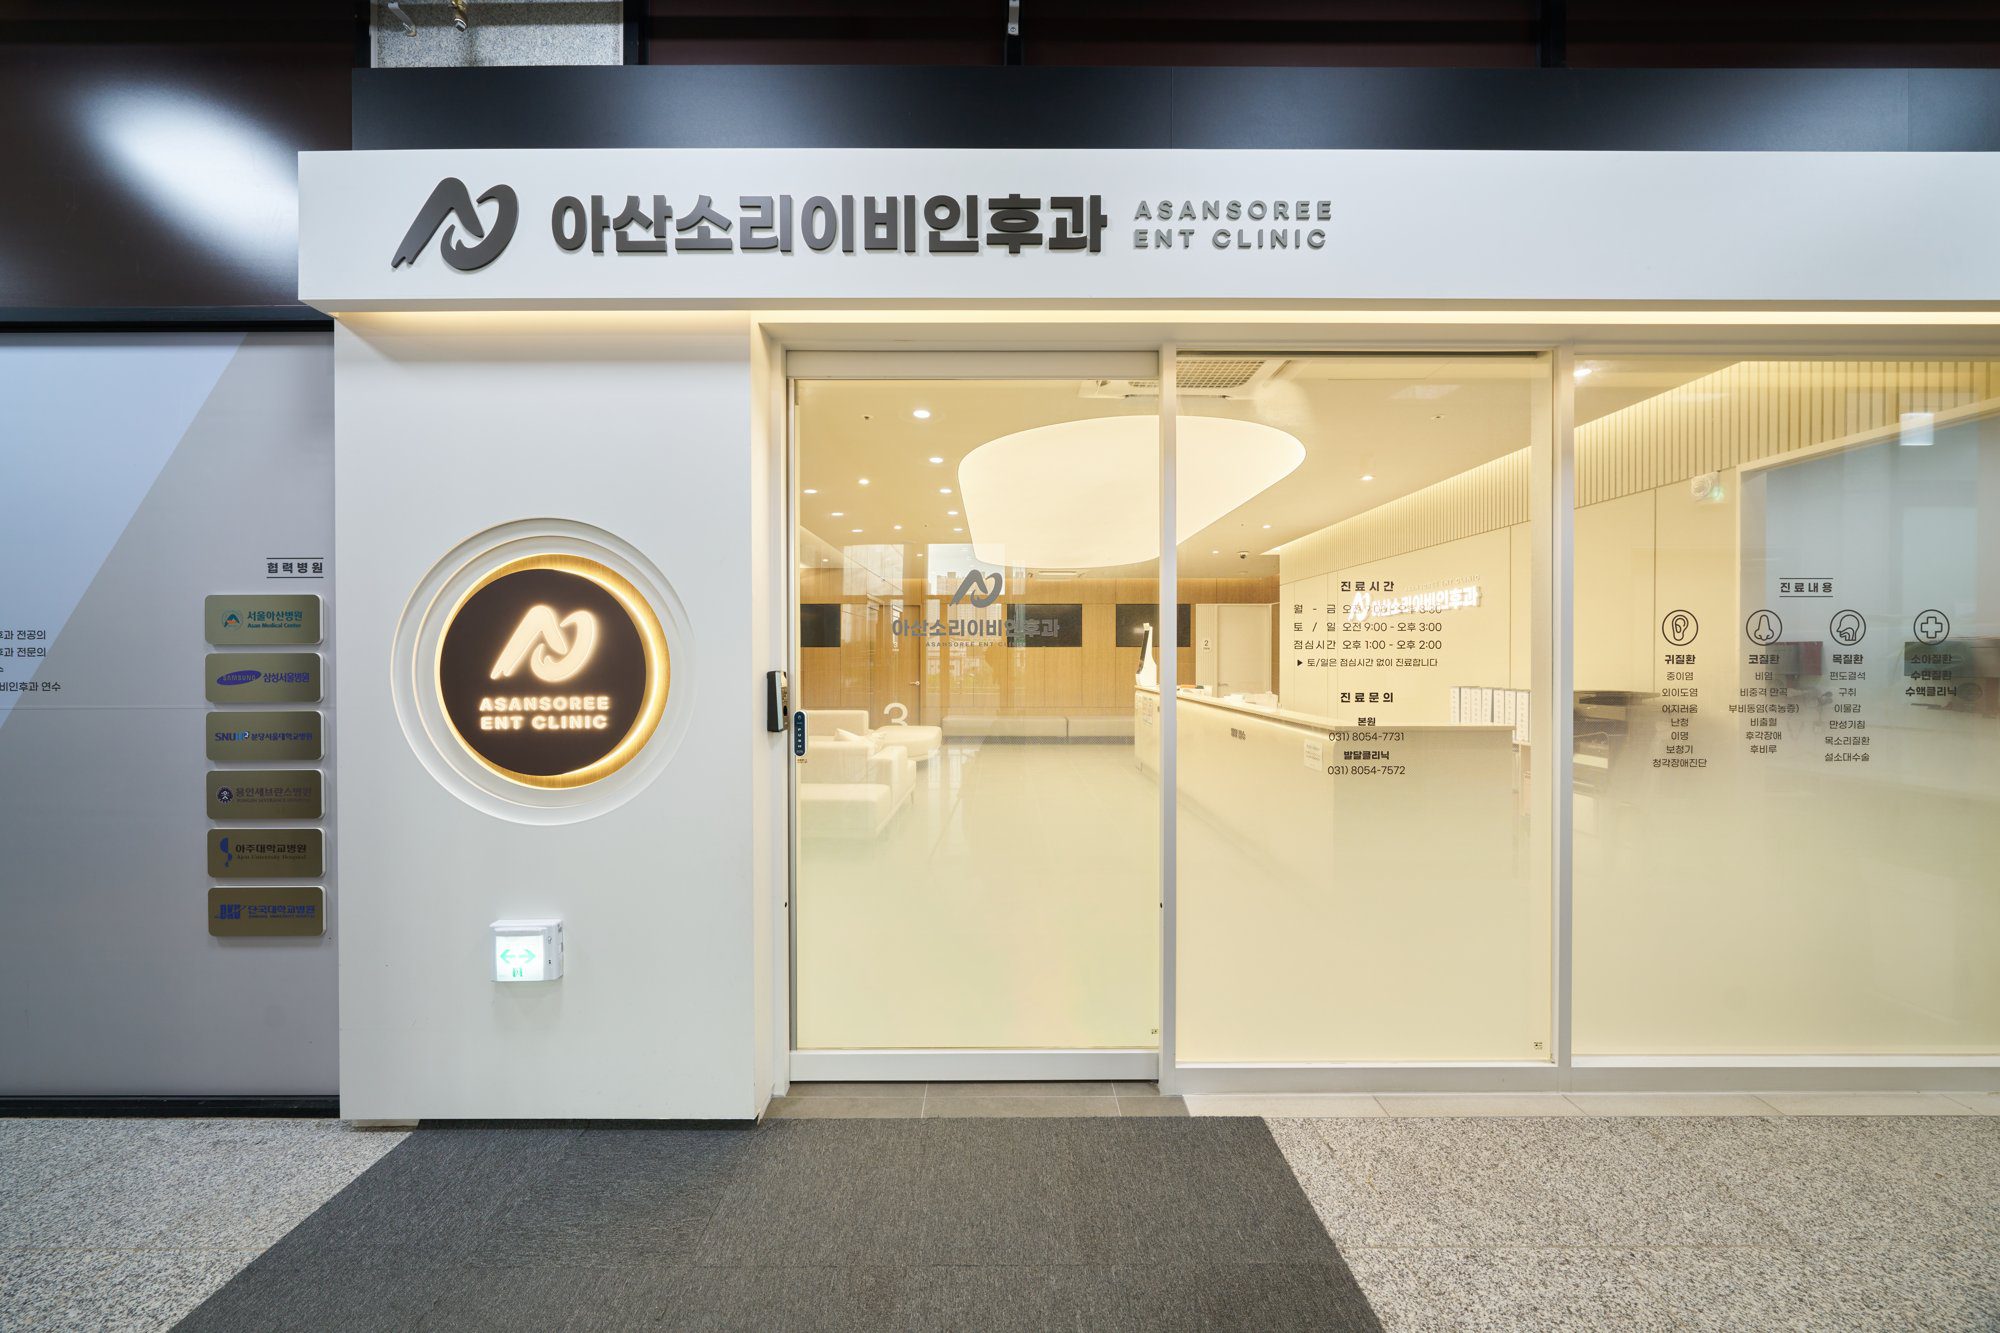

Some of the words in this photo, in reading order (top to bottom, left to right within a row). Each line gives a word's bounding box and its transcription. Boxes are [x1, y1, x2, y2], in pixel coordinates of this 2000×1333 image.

[1134, 200, 1332, 220] ASANSOREE
[551, 193, 1108, 253] 아산소리이비인후과
[1134, 229, 1195, 248] ENT
[1212, 229, 1326, 248] CLINIC
[267, 562, 323, 574] 협력병원
[1340, 581, 1394, 592] 진료시간
[1780, 582, 1833, 593] 진료내용
[1294, 604, 1303, 614] 월
[1326, 604, 1336, 614] 금
[248, 610, 302, 622] 서울아산병원
[892, 619, 1060, 638] 아산소리이비인후과
[1294, 622, 1303, 632] 토
[1326, 622, 1336, 632] 일
[1342, 622, 1362, 632] 오전
[1364, 622, 1388, 632] 9:00
[1397, 622, 1416, 632] 오후
[1419, 622, 1442, 632] 3:00
[17, 630, 46, 640] 전공의
[1294, 640, 1336, 650] 점심시간
[1342, 640, 1362, 650] 오후
[1365, 640, 1386, 650] 1:00
[1396, 640, 1416, 650] 오후
[1419, 640, 1442, 650] 2:00
[17, 648, 46, 657] 전문의
[1308, 659, 1336, 667] 토/일은
[1340, 659, 1374, 667] 점심시간
[1376, 659, 1393, 667] 없이
[1396, 659, 1438, 667] 진료합니다
[1664, 654, 1696, 664] 귀질환
[1748, 654, 1780, 664] 코질환
[1832, 654, 1864, 664] 목질환
[1910, 654, 1952, 664] 소아질환
[264, 672, 310, 683] 삼성서울병원
[1666, 672, 1694, 680] 중이염
[1755, 672, 1773, 680] 비염
[1830, 672, 1866, 680] 편도결석
[0, 682, 38, 692] 비인후과
[42, 682, 61, 691] 연수
[1838, 688, 1857, 696] 구취
[1905, 686, 1957, 696] 수액클리닉
[1340, 692, 1394, 703] 진료문의
[1662, 688, 1698, 697] 외이도염
[1740, 688, 1766, 697] 비중격
[1770, 688, 1788, 696] 만곡
[478, 696, 610, 712] ASANSOREE
[1662, 704, 1698, 714] 어지러움
[1728, 704, 1800, 714] 부비동염(축농증)
[1834, 704, 1861, 713] 이물감
[480, 716, 524, 730] ENT
[531, 715, 608, 730] CLINIC
[1358, 717, 1376, 726] 본원
[1670, 718, 1688, 727] 난청
[1750, 718, 1777, 727] 비출혈
[1830, 720, 1866, 730] 만성기침
[1328, 732, 1350, 742] 031)
[1352, 732, 1404, 742] 8054-7731
[1670, 732, 1688, 740] 이명
[1746, 732, 1782, 740] 후각장애
[1824, 736, 1870, 746] 목소리질환
[1666, 745, 1694, 754] 보청기
[1750, 744, 1777, 754] 후비루
[1344, 750, 1390, 760] 발달클리닉
[1824, 752, 1870, 762] 설소대수술
[1652, 758, 1707, 768] 청각장애진단
[1328, 766, 1348, 776] 031)
[1351, 766, 1406, 775] 8054-7572
[236, 844, 306, 854] 아주대학교병원
